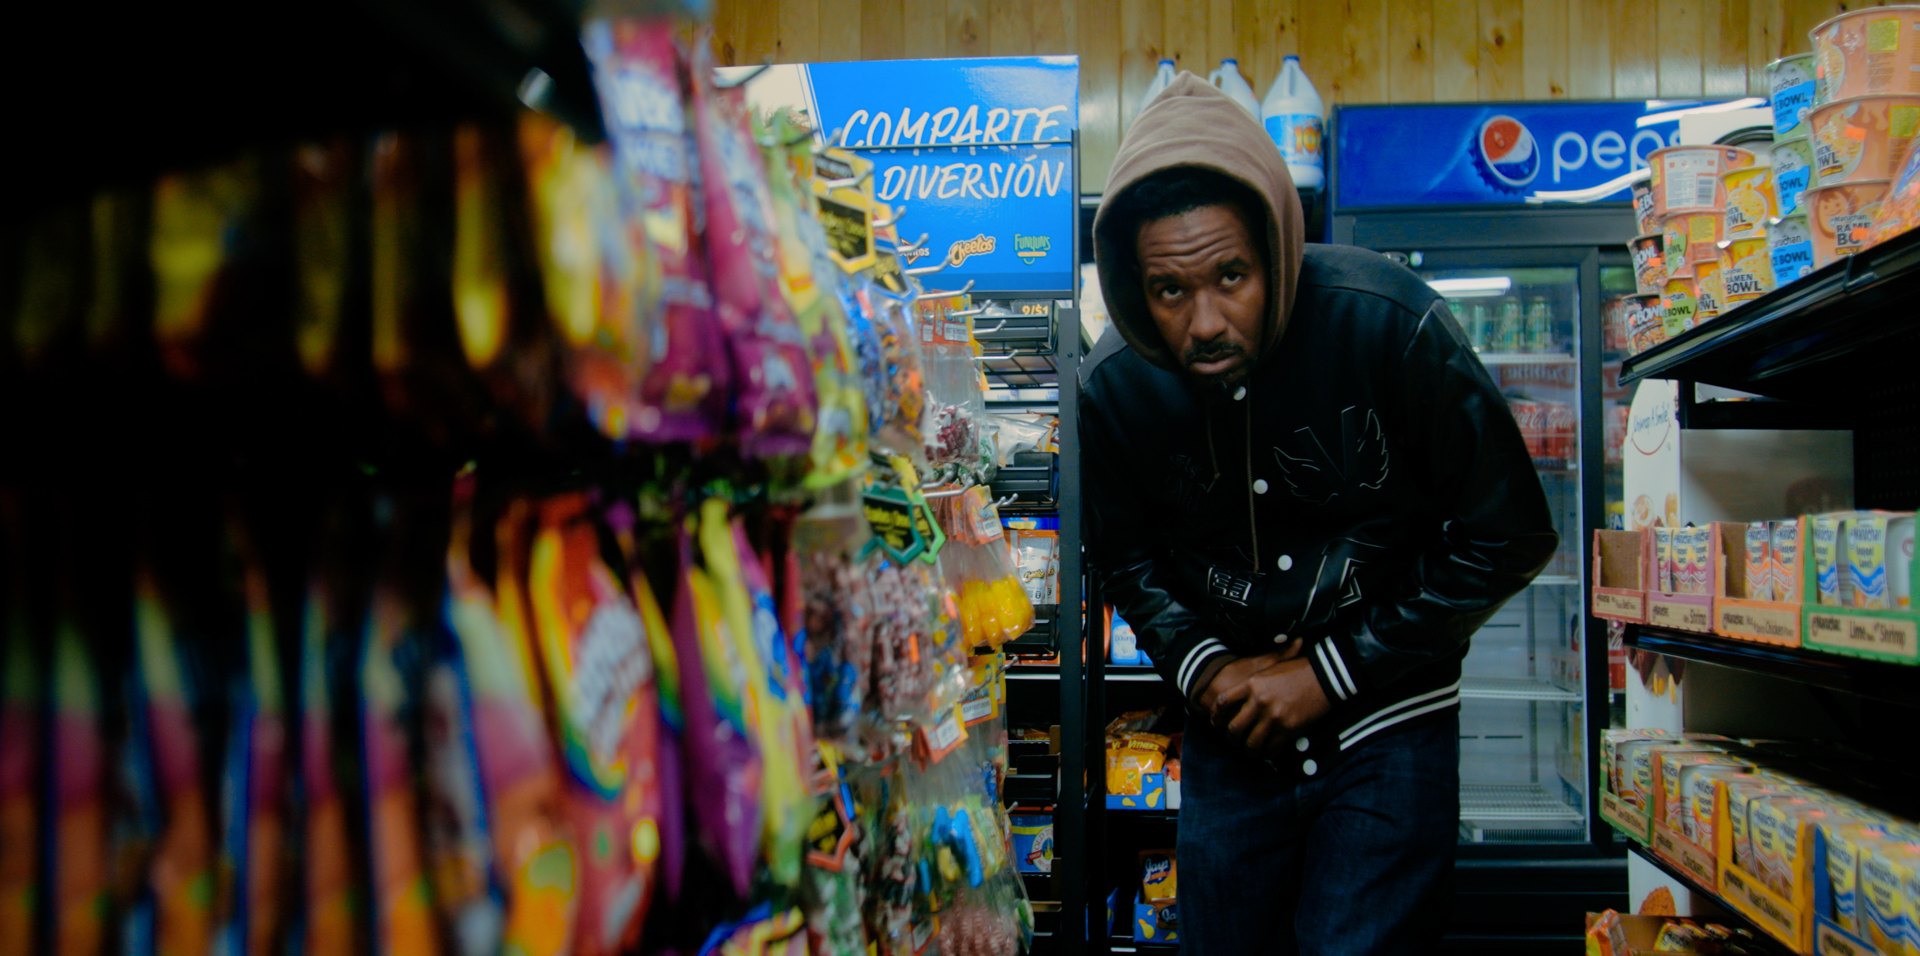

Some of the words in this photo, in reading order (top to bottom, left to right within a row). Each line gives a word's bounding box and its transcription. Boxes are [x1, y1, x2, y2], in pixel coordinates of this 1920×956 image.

[840, 104, 1067, 154] COMPARTE
[1553, 130, 1680, 183] pep
[878, 155, 1065, 201] DIVERSIÓN
[950, 232, 994, 267] Cheetos
[1779, 250, 1811, 265] BOWL
[1727, 281, 1762, 295] BOWL
[1669, 306, 1692, 317] BOWL
